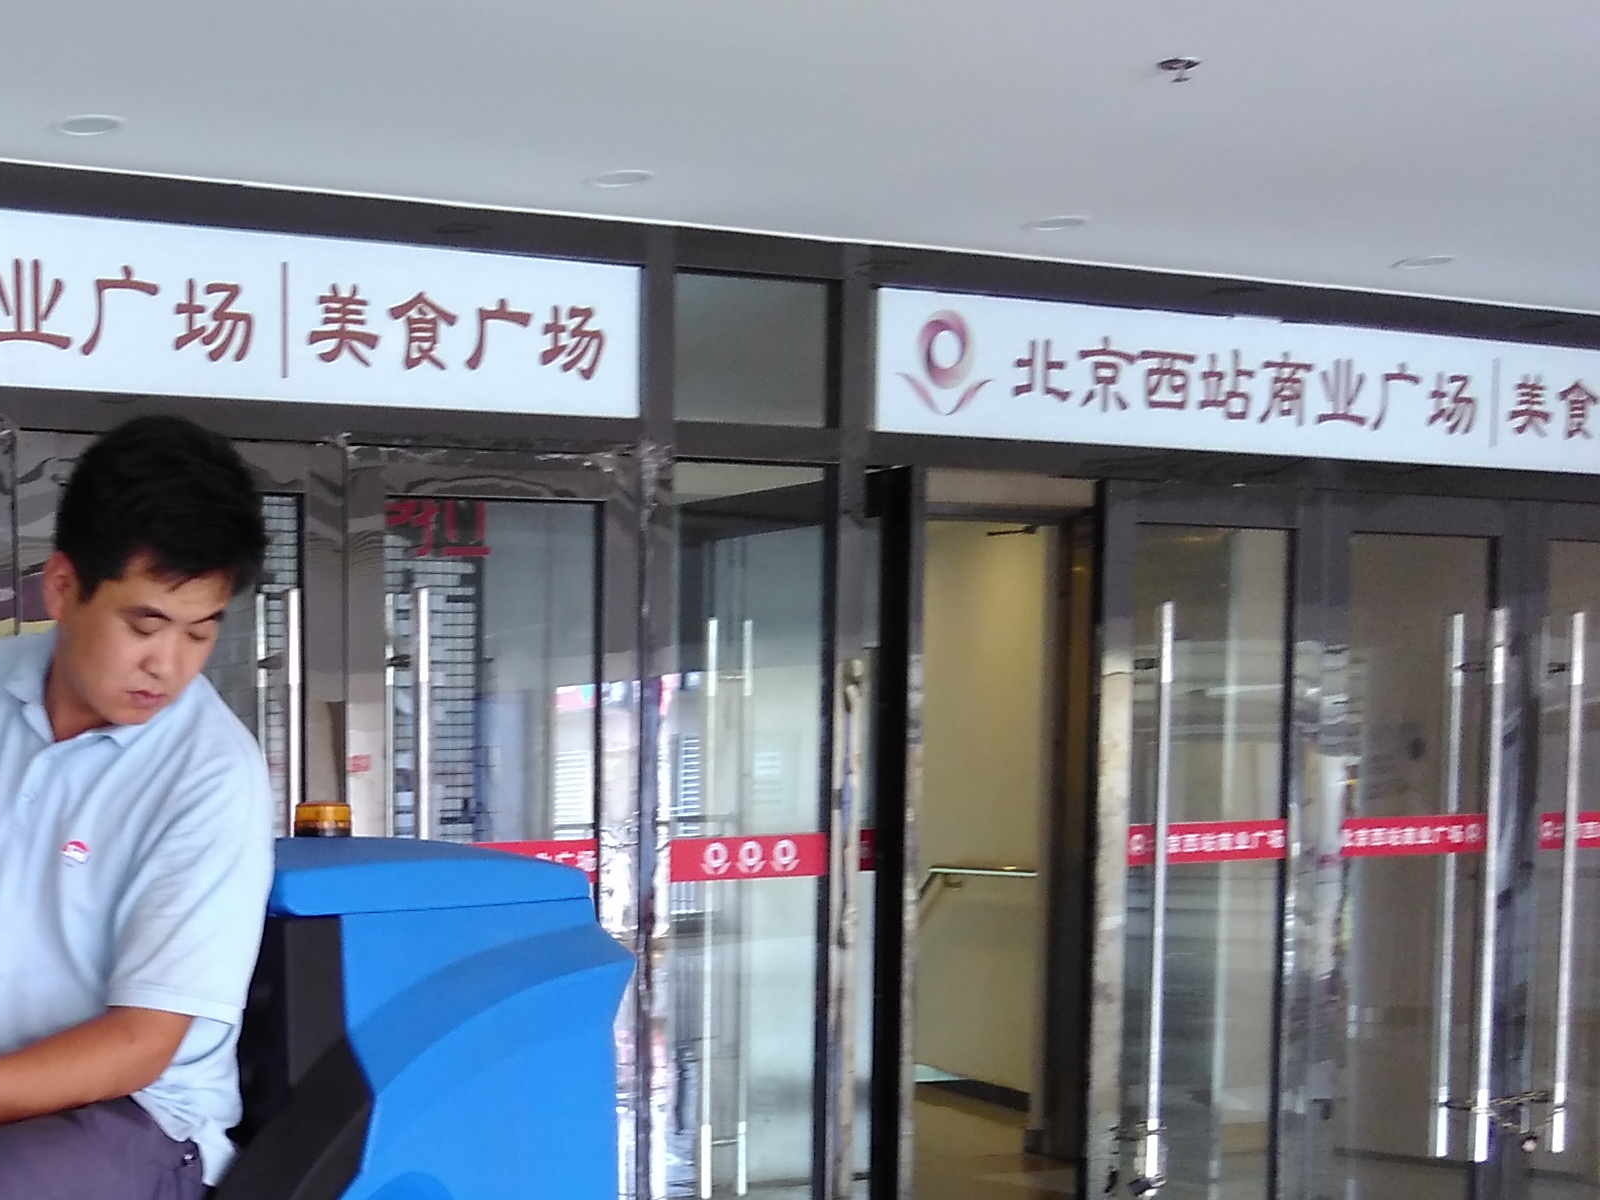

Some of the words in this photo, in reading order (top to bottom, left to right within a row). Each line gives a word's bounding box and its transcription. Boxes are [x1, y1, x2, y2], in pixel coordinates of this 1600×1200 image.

[308, 282, 606, 381] 美食广场
[1011, 337, 1478, 435] 北京西站商业广场
[1507, 374, 1600, 440] 美食
